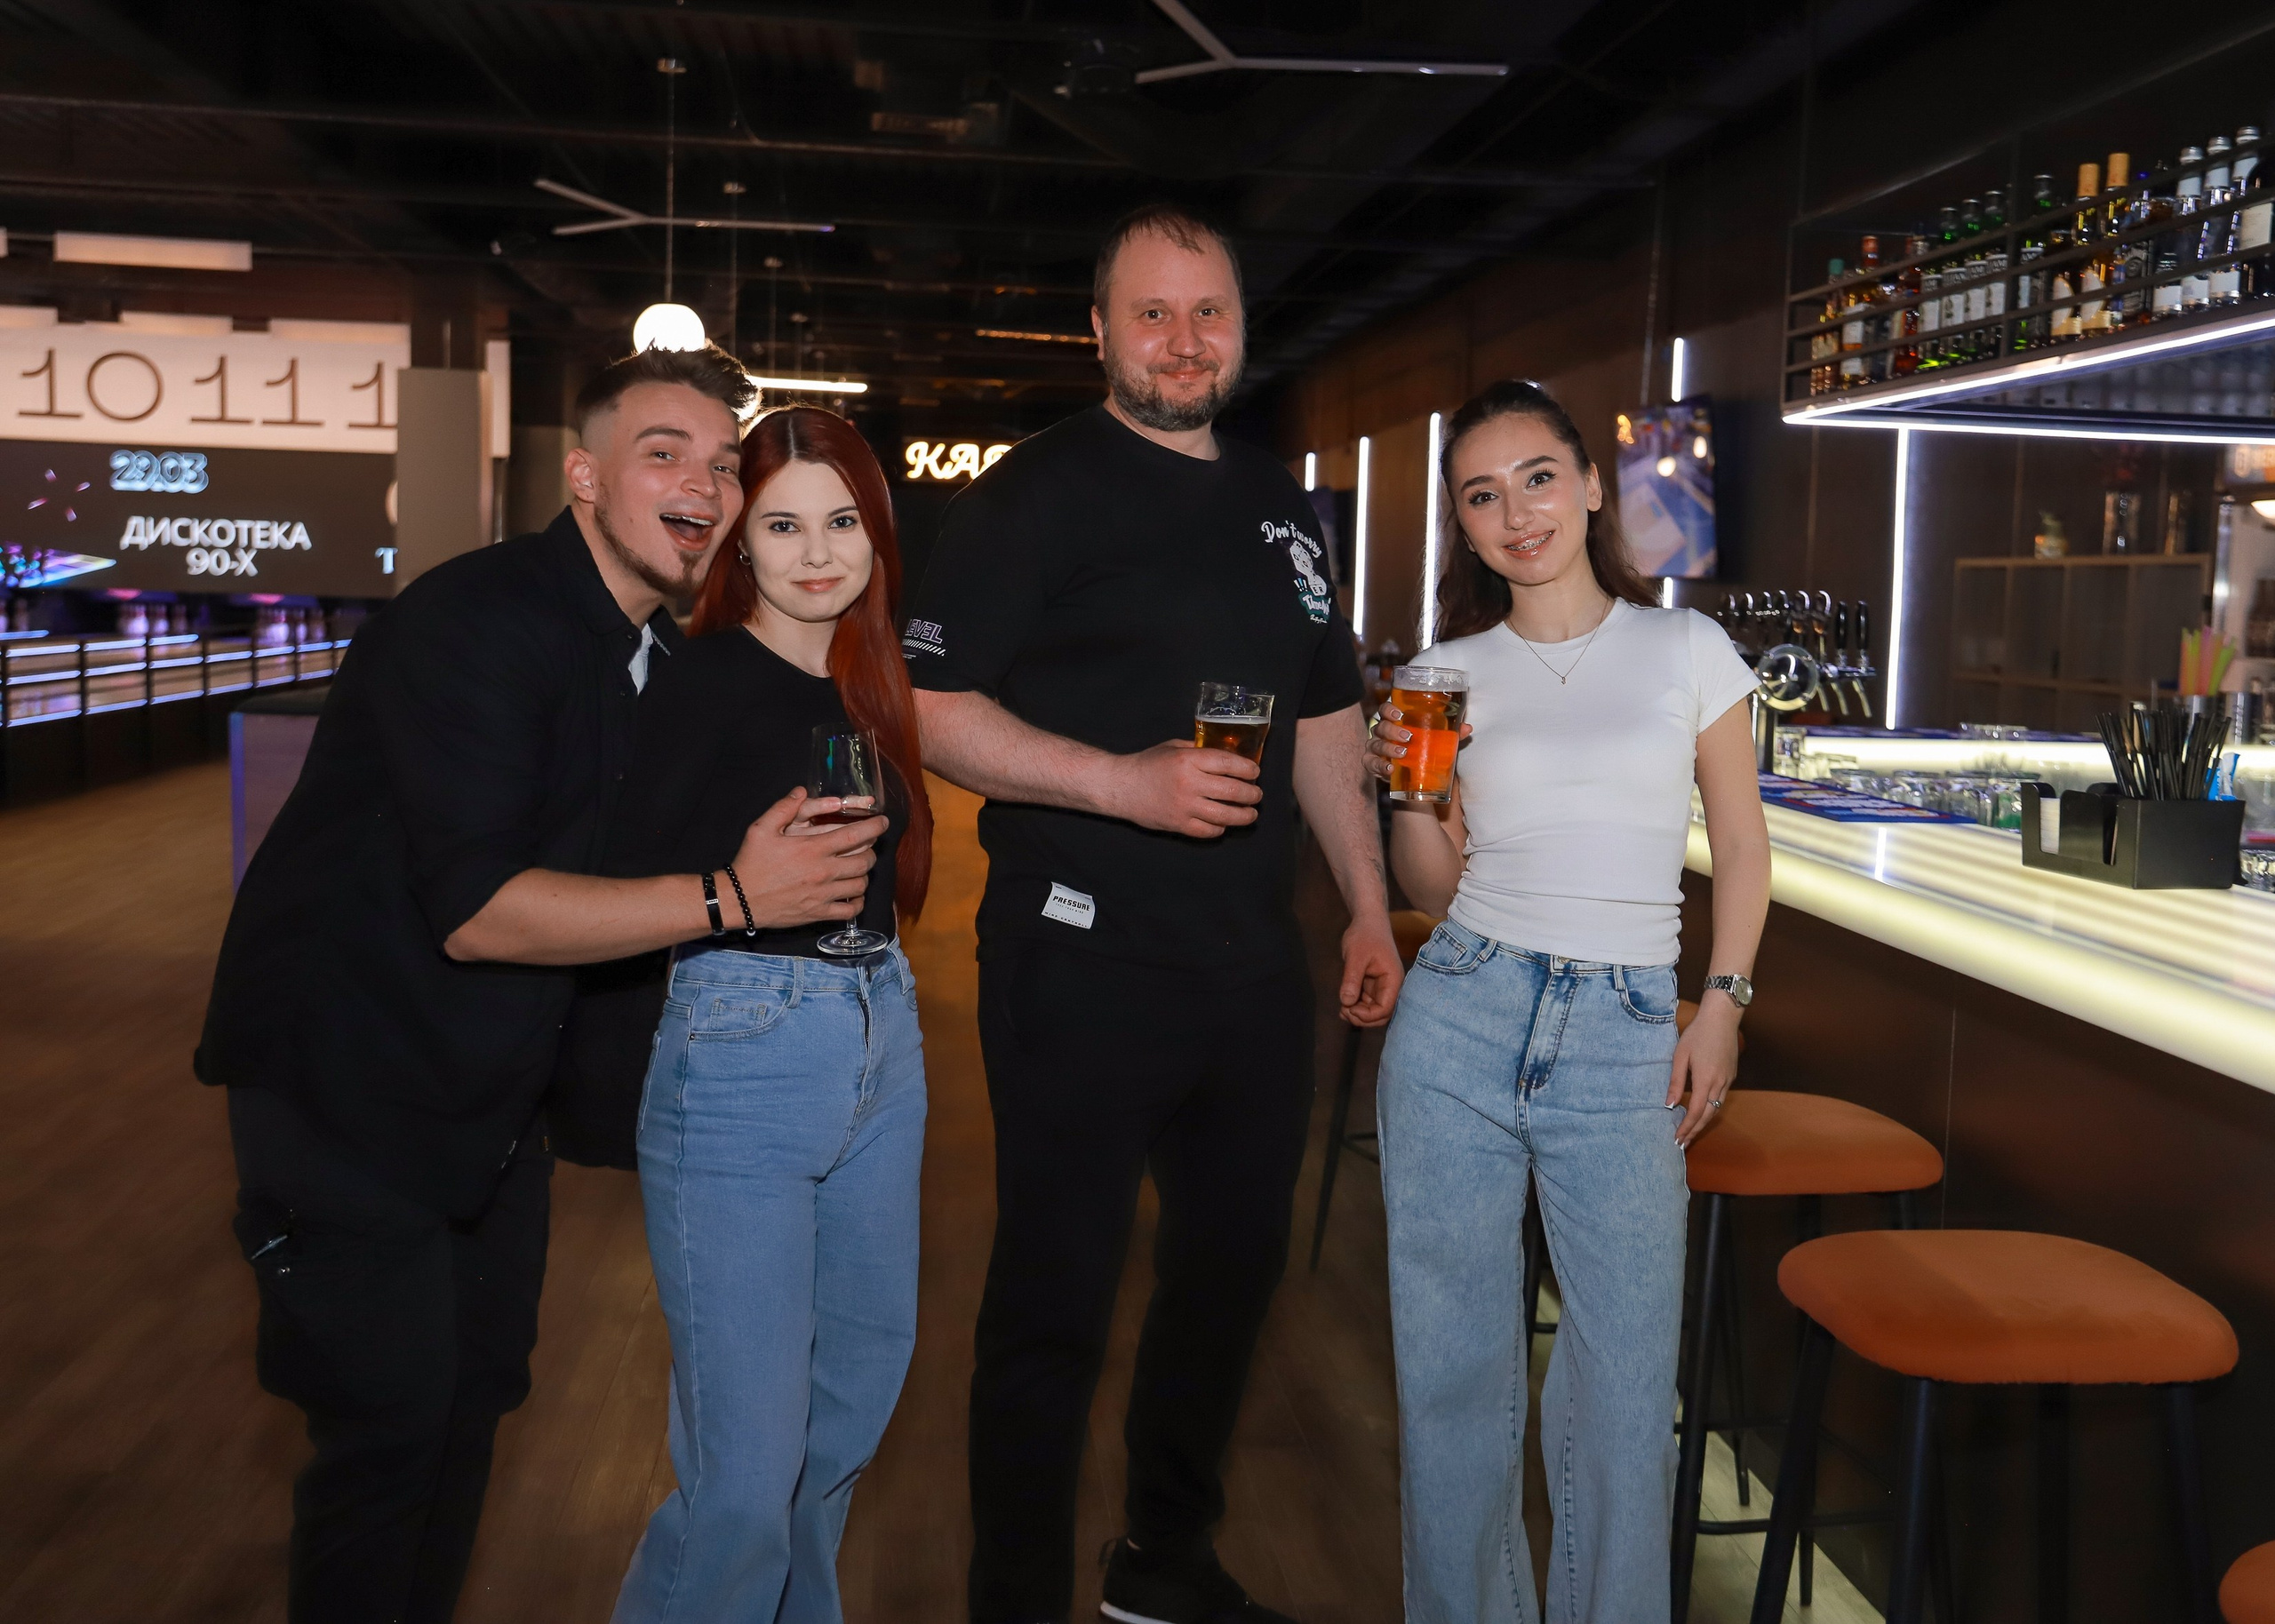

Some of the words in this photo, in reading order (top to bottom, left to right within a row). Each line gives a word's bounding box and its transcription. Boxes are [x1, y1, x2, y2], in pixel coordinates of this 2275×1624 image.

[17, 348, 164, 422] 10
[119, 515, 313, 552] ДИСКОТЕКА
[1052, 896, 1090, 912] PRESSURE
